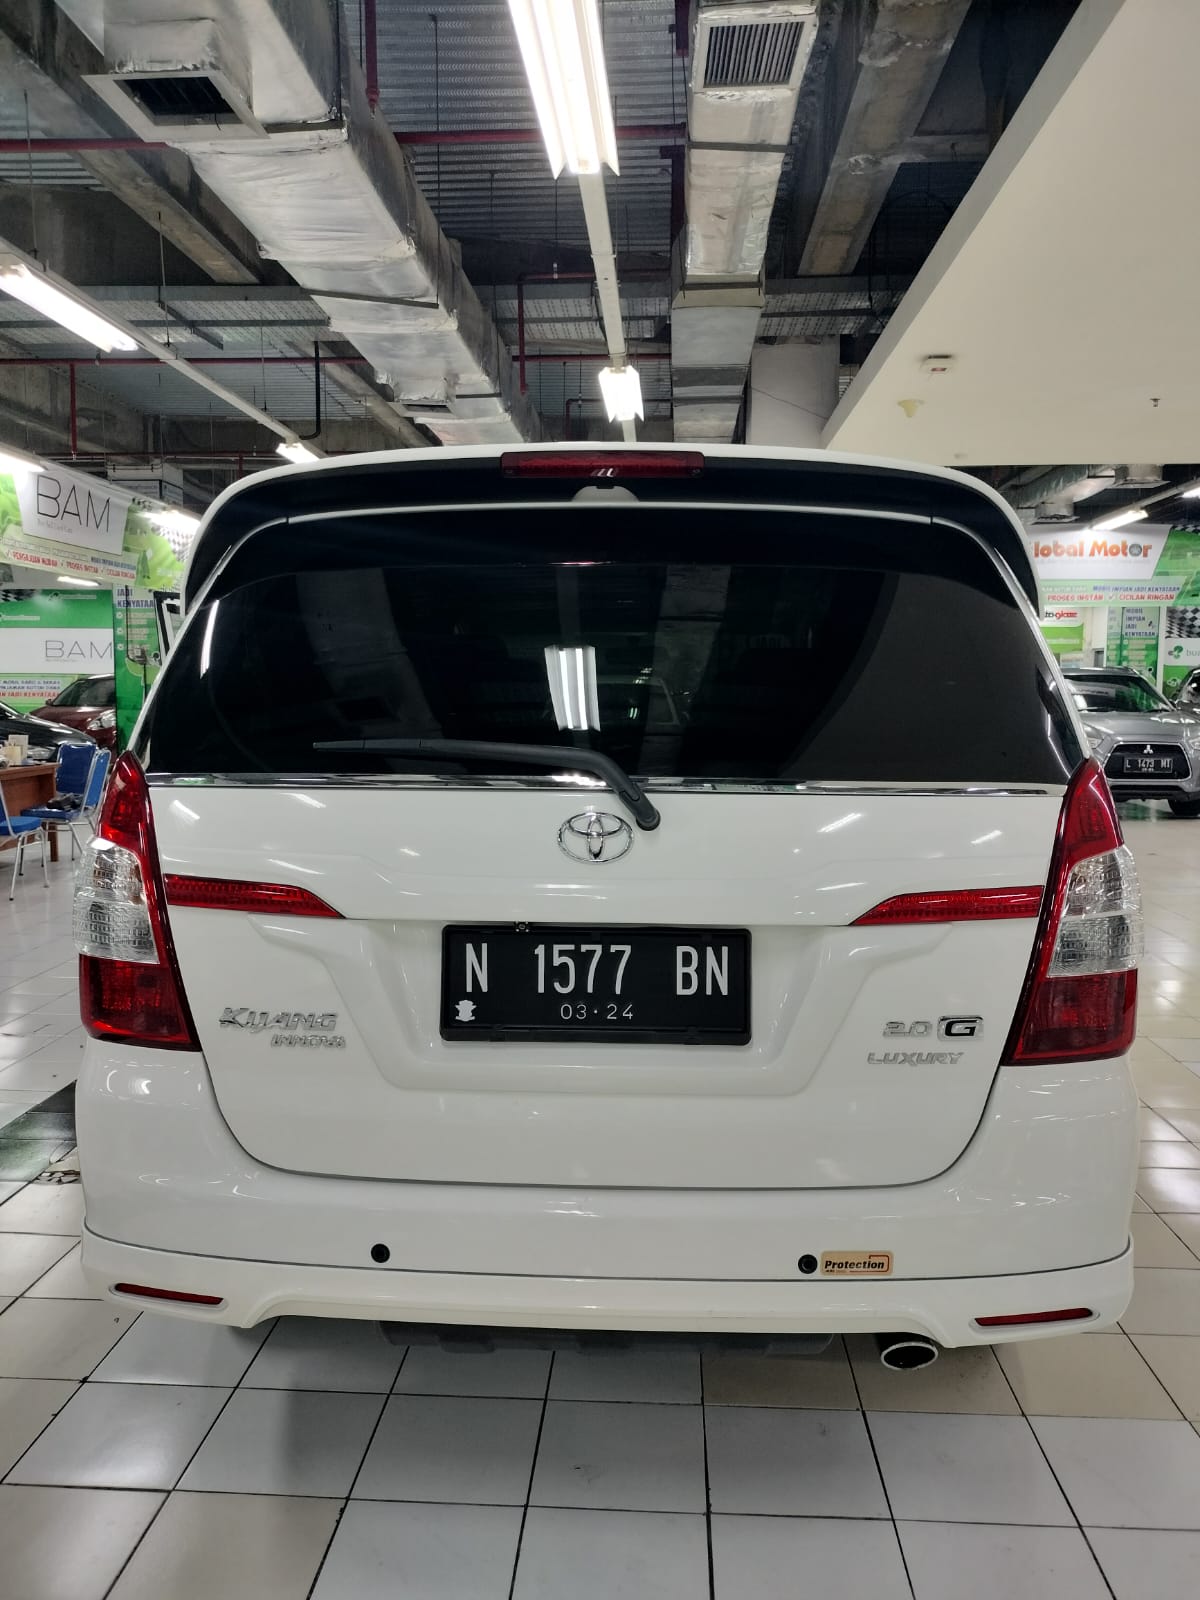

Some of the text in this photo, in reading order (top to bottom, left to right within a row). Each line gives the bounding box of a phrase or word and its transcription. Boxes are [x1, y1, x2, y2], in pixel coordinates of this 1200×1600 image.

[37, 474, 110, 533] BAM
[1089, 540, 1152, 558] Motor
[45, 640, 113, 658] BAM
[465, 943, 729, 996] N 1577 BN
[945, 1020, 978, 1036] G
[867, 1052, 965, 1067] LUXURY
[825, 1260, 885, 1269] Protection
